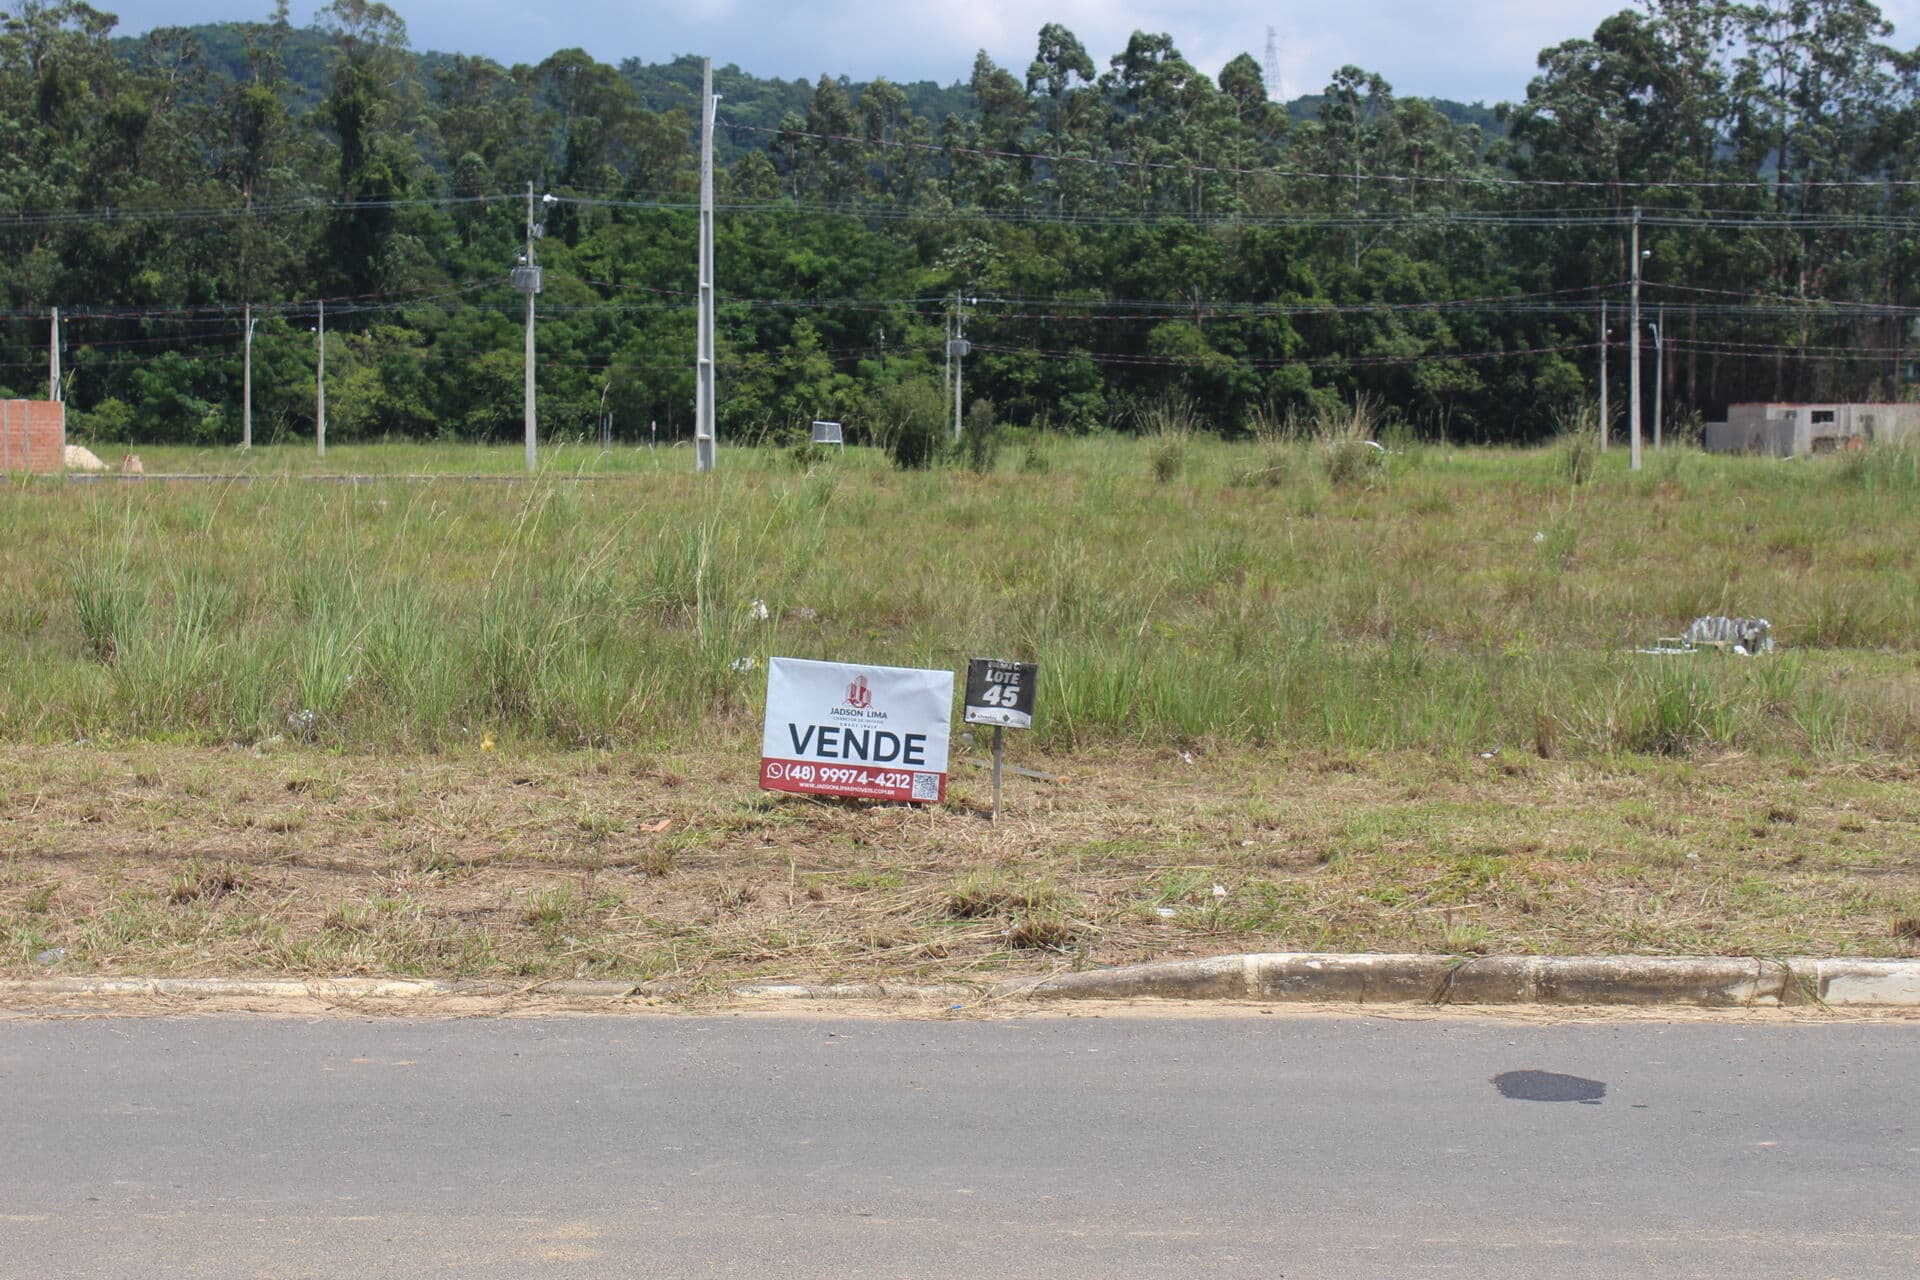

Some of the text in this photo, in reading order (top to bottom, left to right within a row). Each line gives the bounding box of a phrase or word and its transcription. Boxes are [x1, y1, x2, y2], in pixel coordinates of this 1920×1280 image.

[985, 670, 1021, 685] LOTE
[982, 685, 1021, 707] 45
[830, 708, 888, 719] JADSON LIMA
[788, 723, 927, 765] VENDE
[785, 764, 910, 789] (48) 99974-4212
